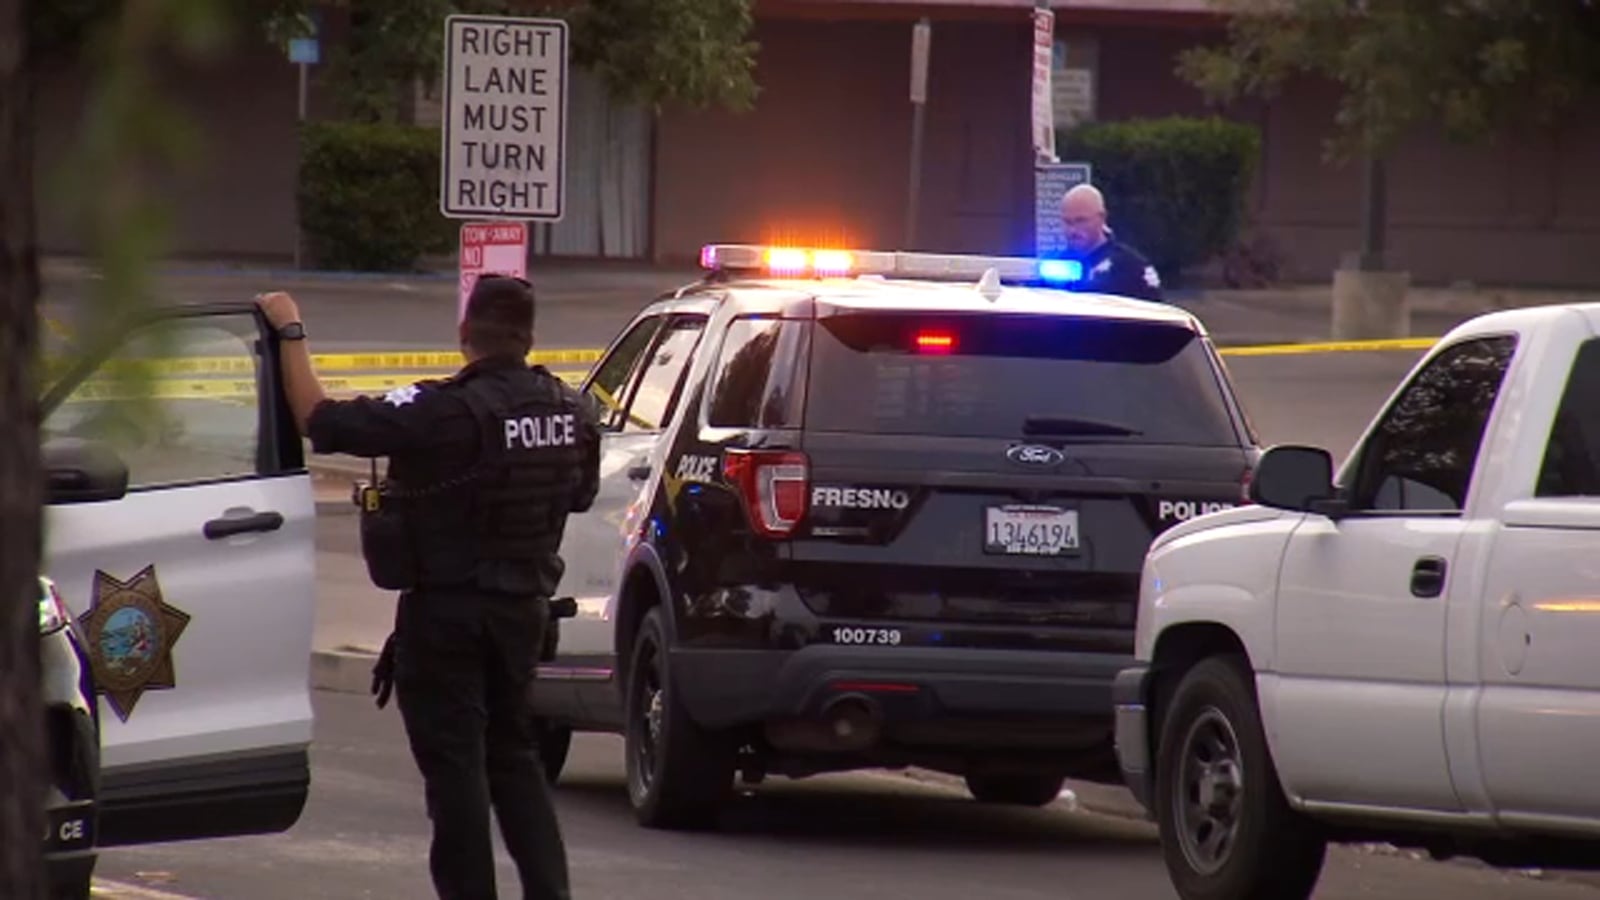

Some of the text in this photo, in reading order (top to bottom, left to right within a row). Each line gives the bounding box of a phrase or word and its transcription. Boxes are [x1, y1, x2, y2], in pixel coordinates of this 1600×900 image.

[462, 27, 551, 57] RIGHT
[464, 65, 547, 96] LANE
[463, 104, 547, 133] MUST
[461, 142, 545, 171] TURN
[458, 179, 548, 209] RIGHT
[464, 246, 480, 266] NO
[504, 414, 576, 449] POLICE
[675, 454, 718, 480] POLICE
[1020, 447, 1050, 462] Ford
[812, 487, 909, 509] FRESNO
[992, 522, 1075, 549] 1346194
[833, 627, 901, 645] 100739
